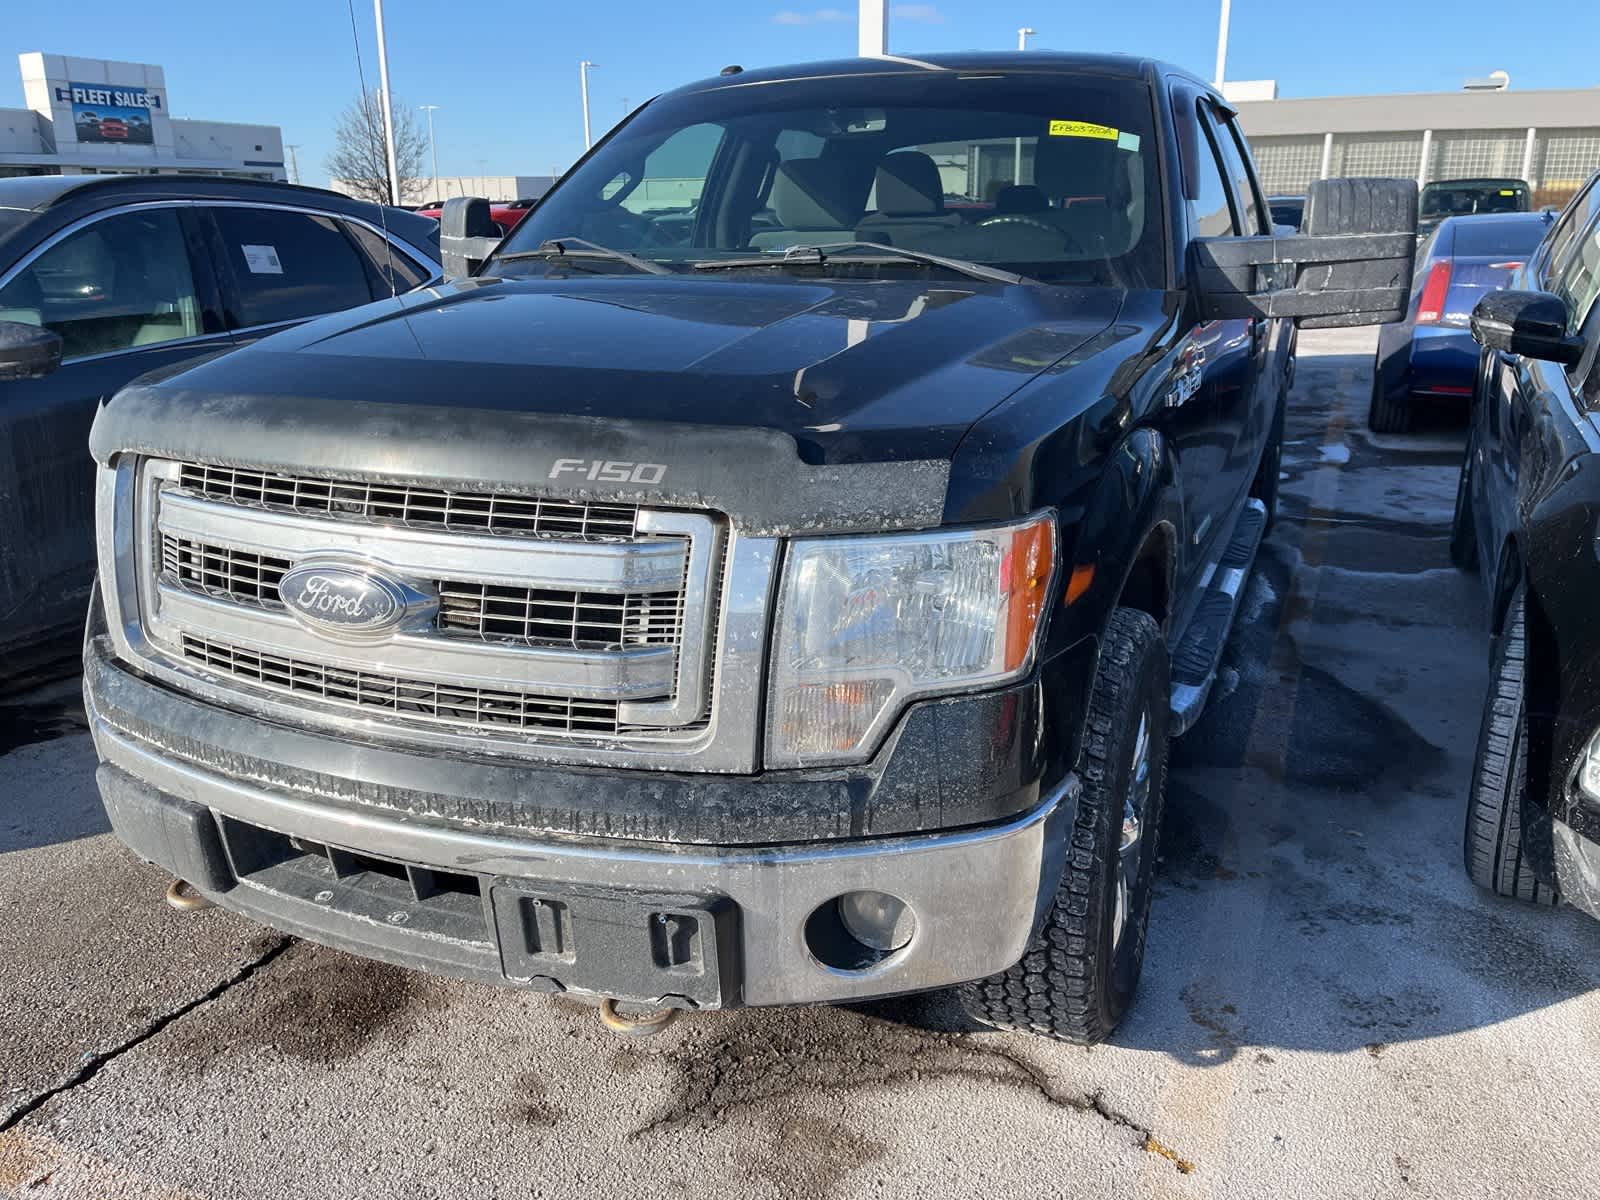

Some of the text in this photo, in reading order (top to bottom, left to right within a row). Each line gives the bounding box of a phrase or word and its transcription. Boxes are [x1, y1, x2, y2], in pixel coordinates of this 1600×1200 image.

[72, 87, 152, 108] FLEET SALES
[548, 458, 667, 484] F-150
[297, 575, 367, 616] Ford
